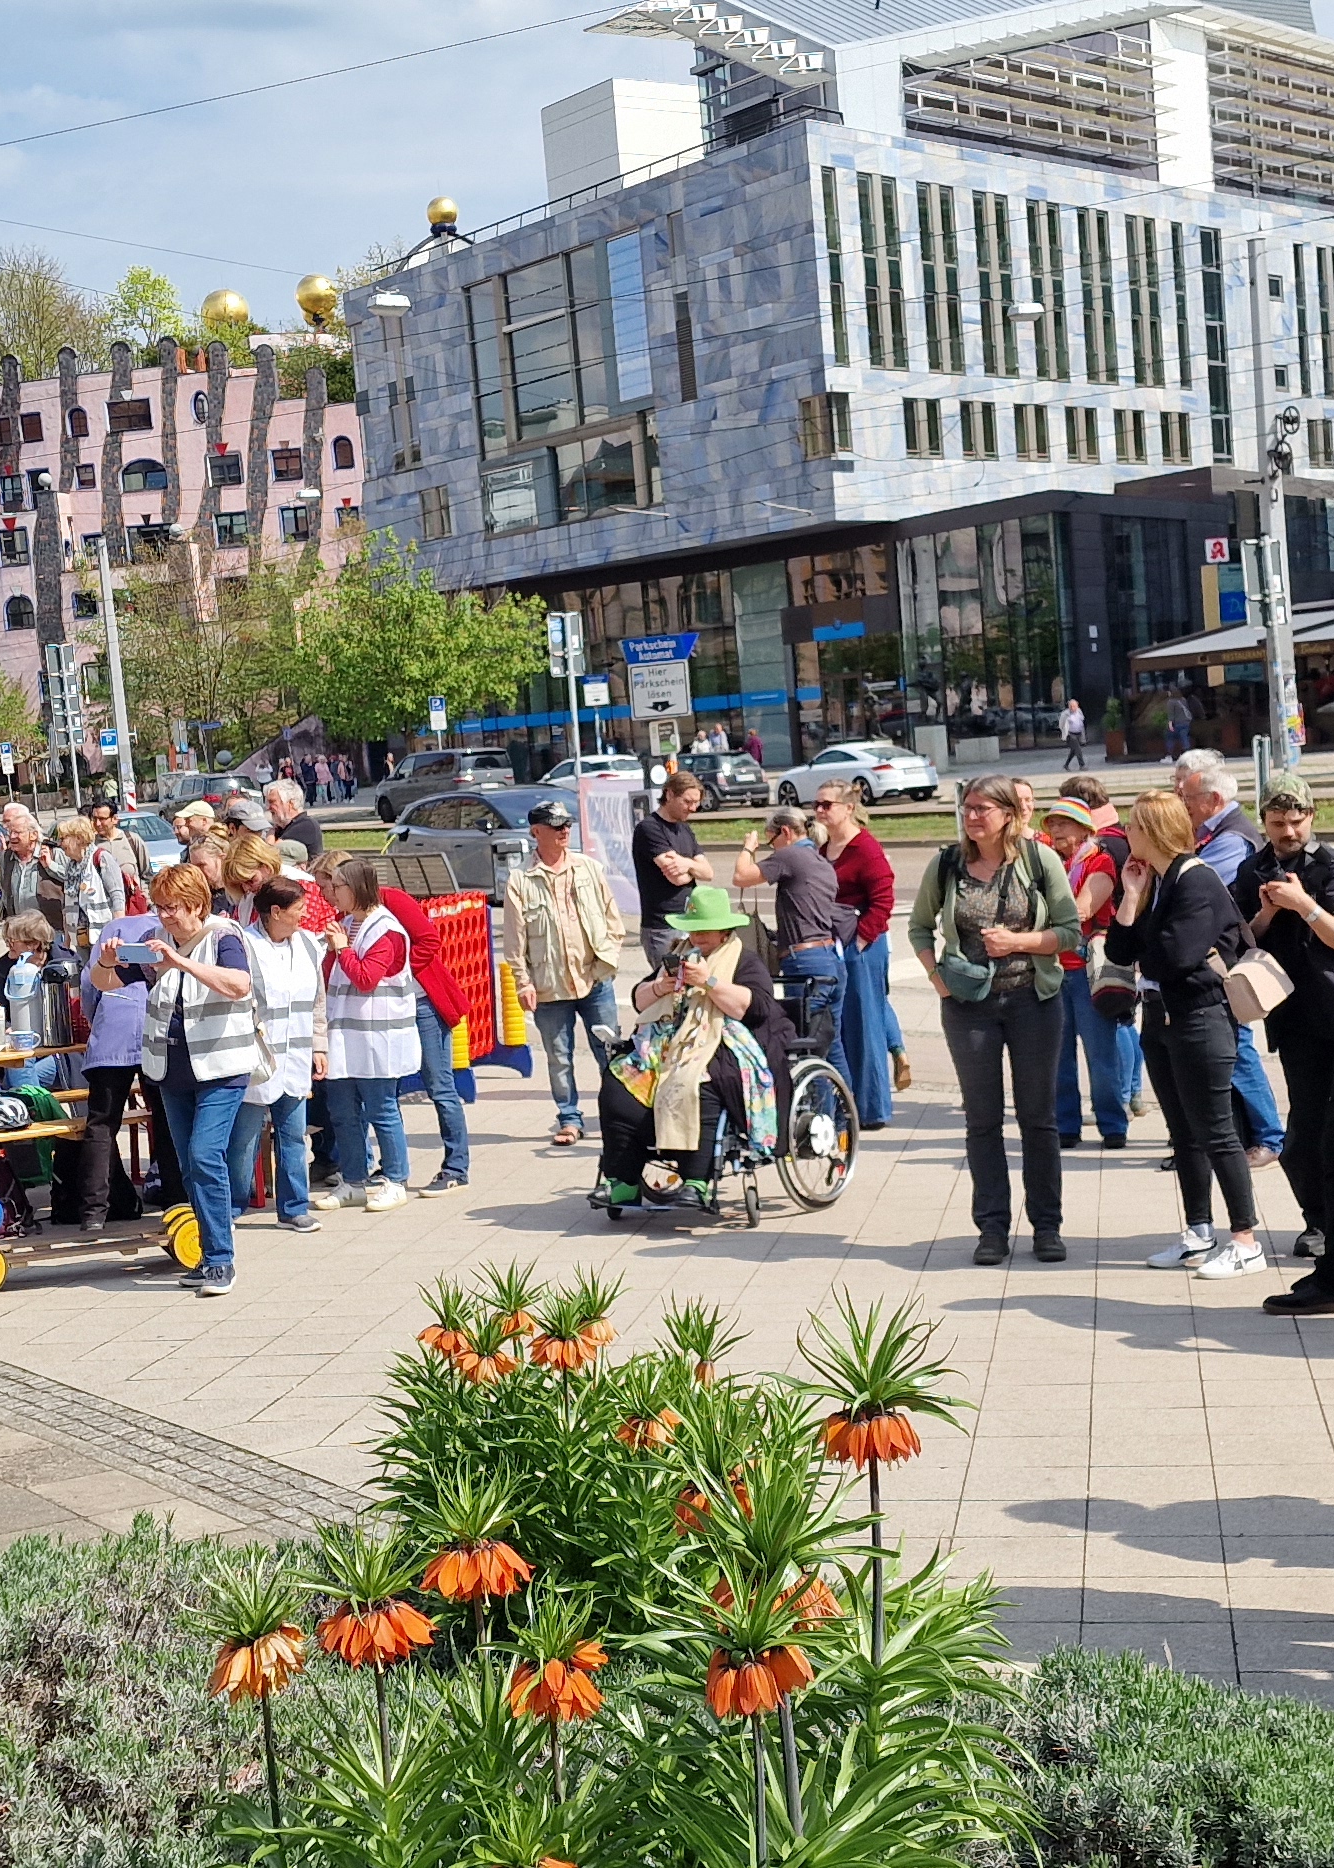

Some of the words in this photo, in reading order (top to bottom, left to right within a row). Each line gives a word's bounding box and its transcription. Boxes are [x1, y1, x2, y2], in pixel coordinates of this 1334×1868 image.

[629, 639, 677, 652] Parkschein
[638, 649, 675, 661] Automat
[647, 667, 668, 678] Hier
[634, 677, 685, 689] Parkschein
[647, 690, 672, 699] lösen
